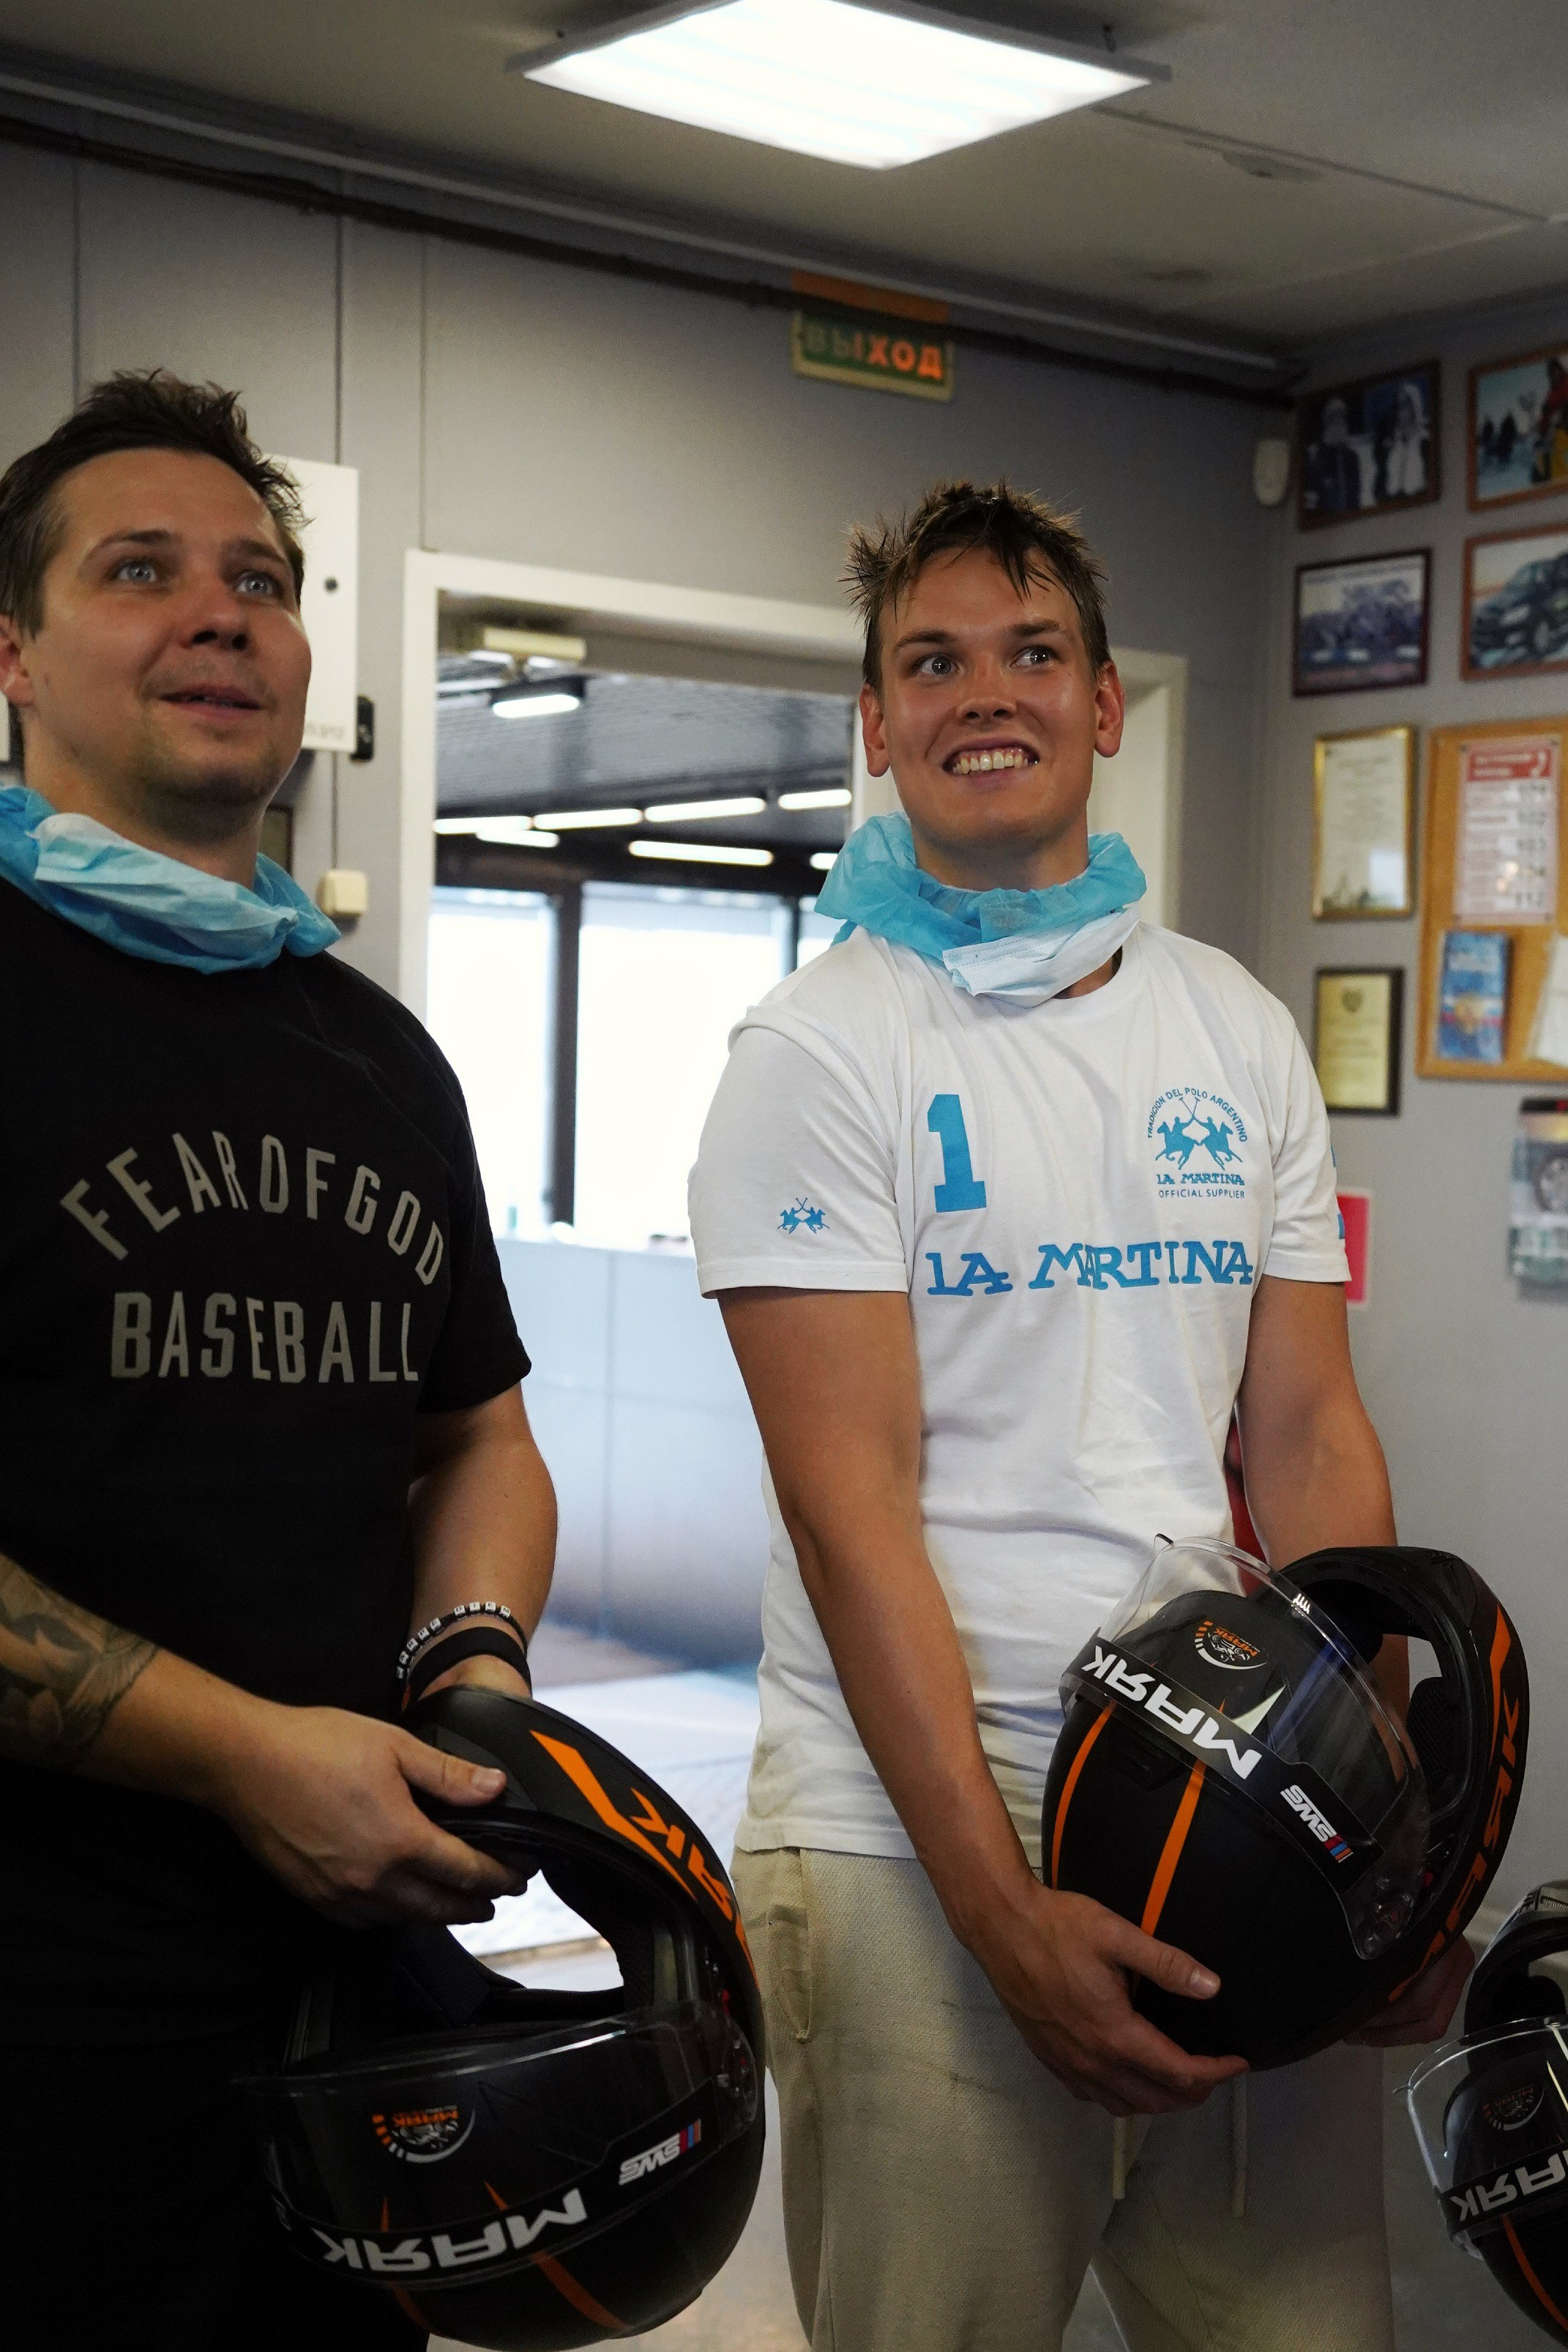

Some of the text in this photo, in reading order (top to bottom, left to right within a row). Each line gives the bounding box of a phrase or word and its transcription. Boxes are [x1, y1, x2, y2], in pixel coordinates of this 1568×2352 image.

[803, 322, 943, 381] ВЫХОД
[1147, 1087, 1248, 1142] TRADICION DEL POLO ARGENTINO
[927, 1094, 987, 1213] 1
[1156, 1173, 1245, 1186] LA MARTINA
[1158, 1189, 1245, 1199] OFFICIAL SUPPLIER
[925, 1239, 1254, 1297] LA MARTINA
[111, 1291, 419, 1384] BASEBALL
[1280, 1784, 1337, 1843] SWS
[1449, 2148, 1568, 2222] АЯК
